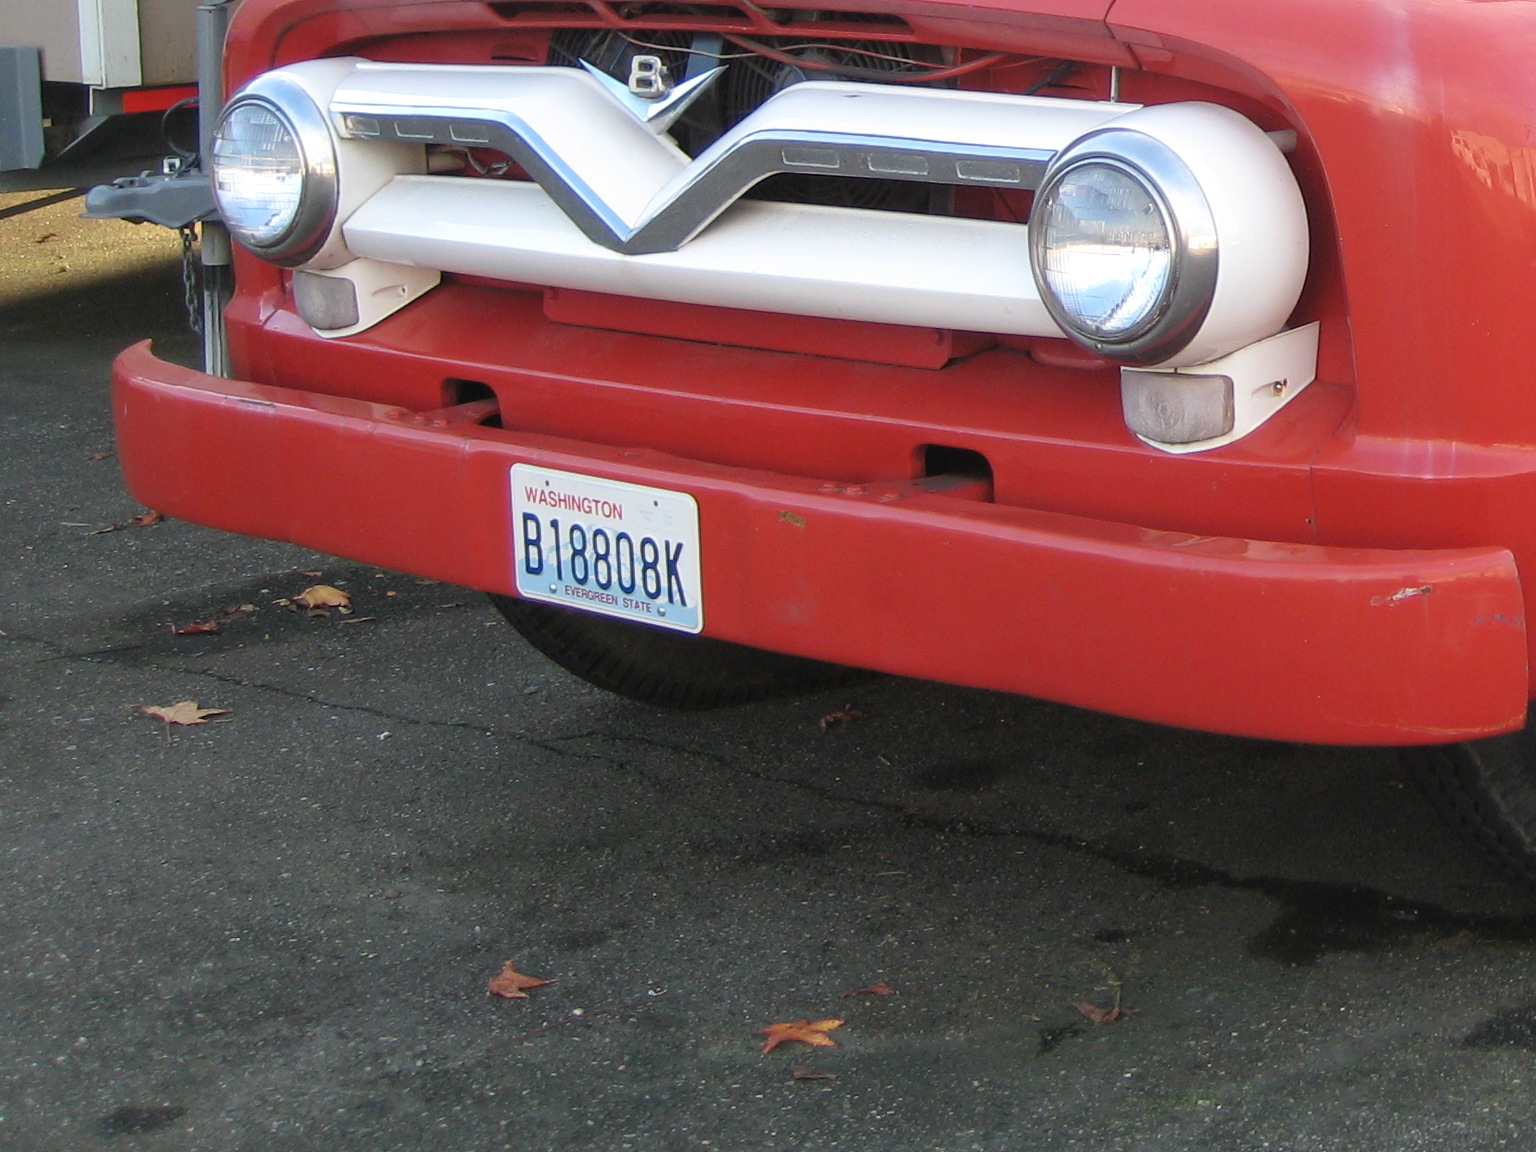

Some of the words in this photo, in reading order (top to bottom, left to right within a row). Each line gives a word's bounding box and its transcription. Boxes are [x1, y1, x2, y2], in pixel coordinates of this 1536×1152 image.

[524, 485, 623, 520] WASHINGTON
[521, 511, 687, 608] B18808K
[564, 584, 619, 606] EVERGREEN
[622, 597, 652, 613] STATE
